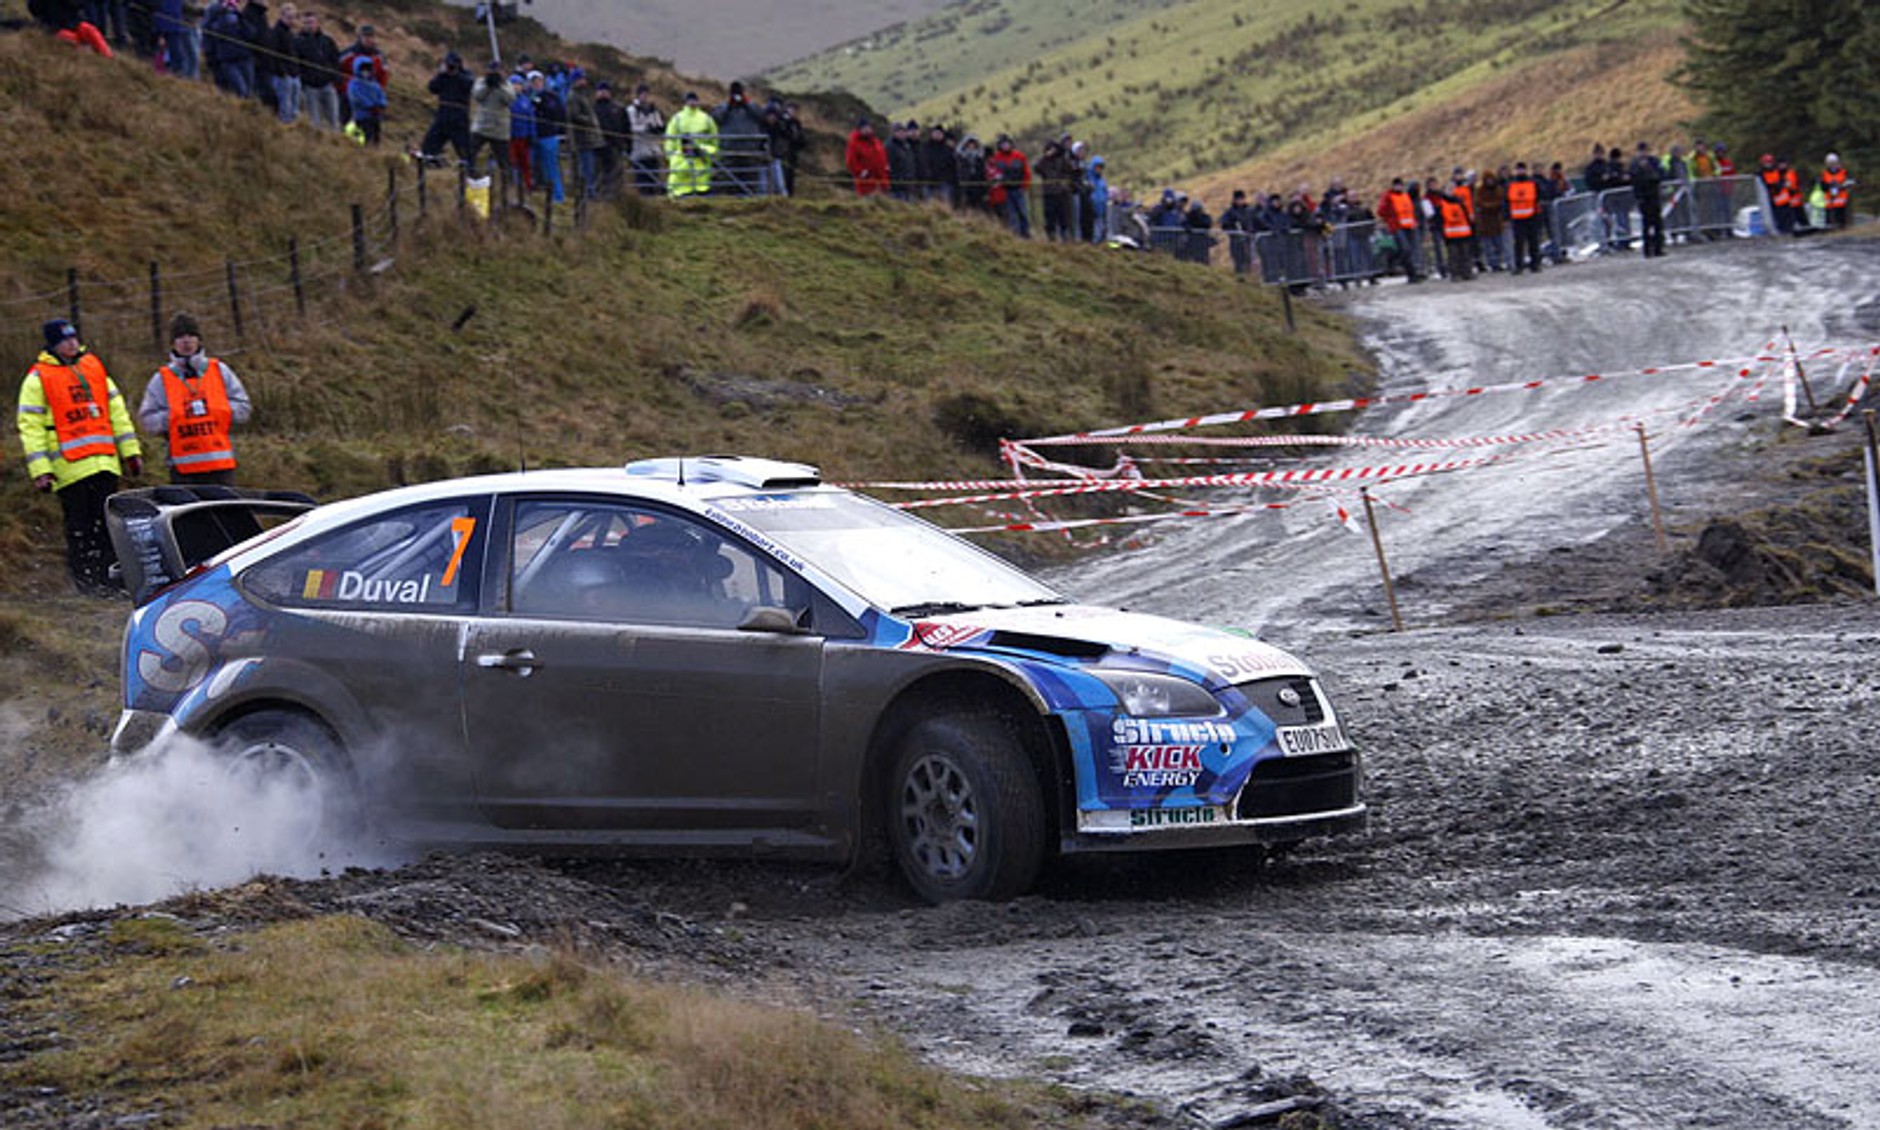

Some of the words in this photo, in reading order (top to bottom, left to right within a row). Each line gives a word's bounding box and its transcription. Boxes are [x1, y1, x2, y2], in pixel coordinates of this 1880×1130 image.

[440, 518, 476, 586] 7
[337, 571, 430, 603] Duval
[1125, 745, 1204, 770] KICK
[1123, 772, 1200, 787] ENERGY
